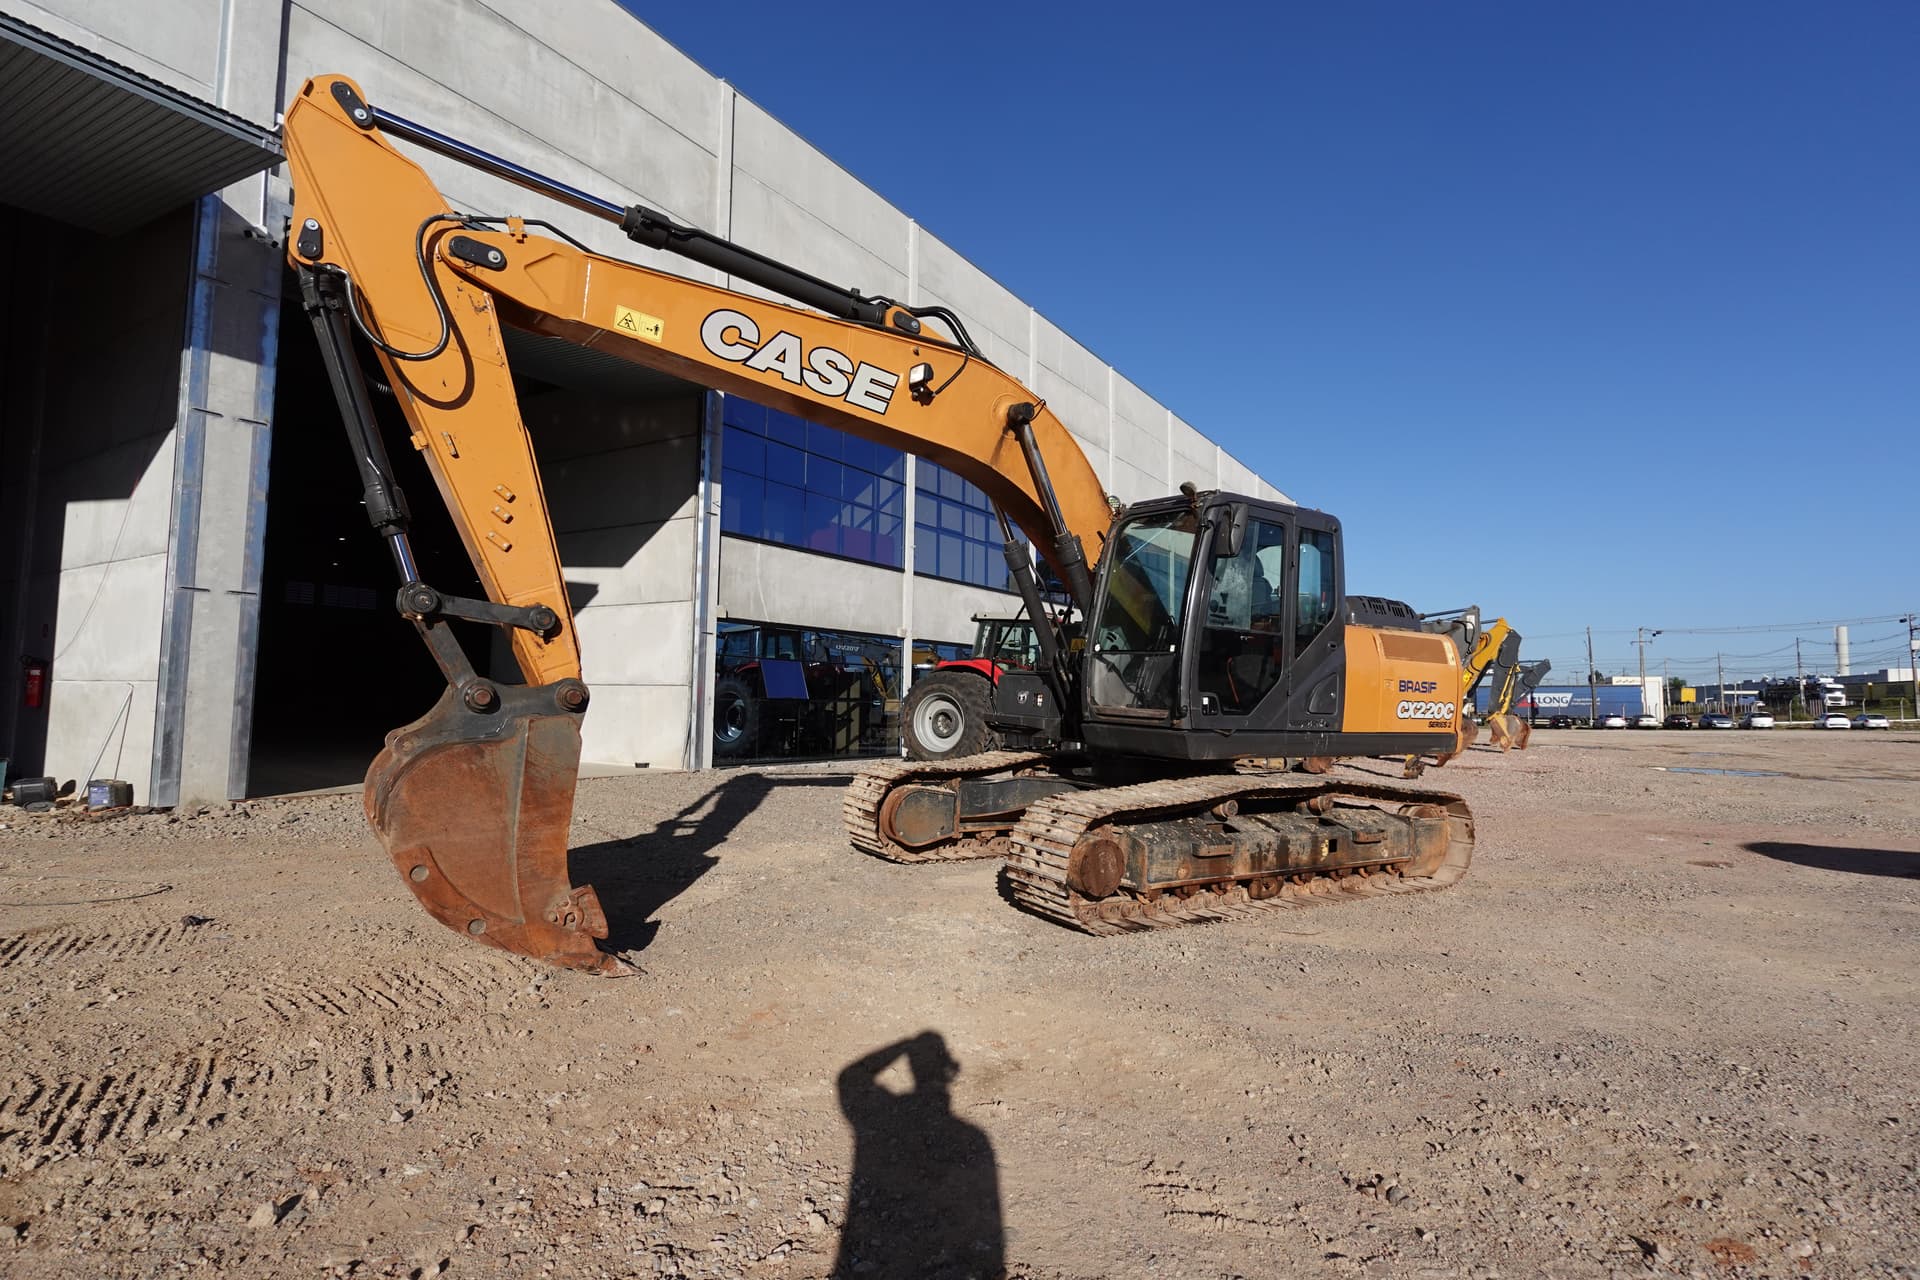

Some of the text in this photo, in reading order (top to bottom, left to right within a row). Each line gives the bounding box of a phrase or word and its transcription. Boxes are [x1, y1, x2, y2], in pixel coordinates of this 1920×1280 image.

[700, 308, 900, 415] CASE
[1398, 680, 1437, 693] BRASIF
[1396, 700, 1455, 720] CX220C
